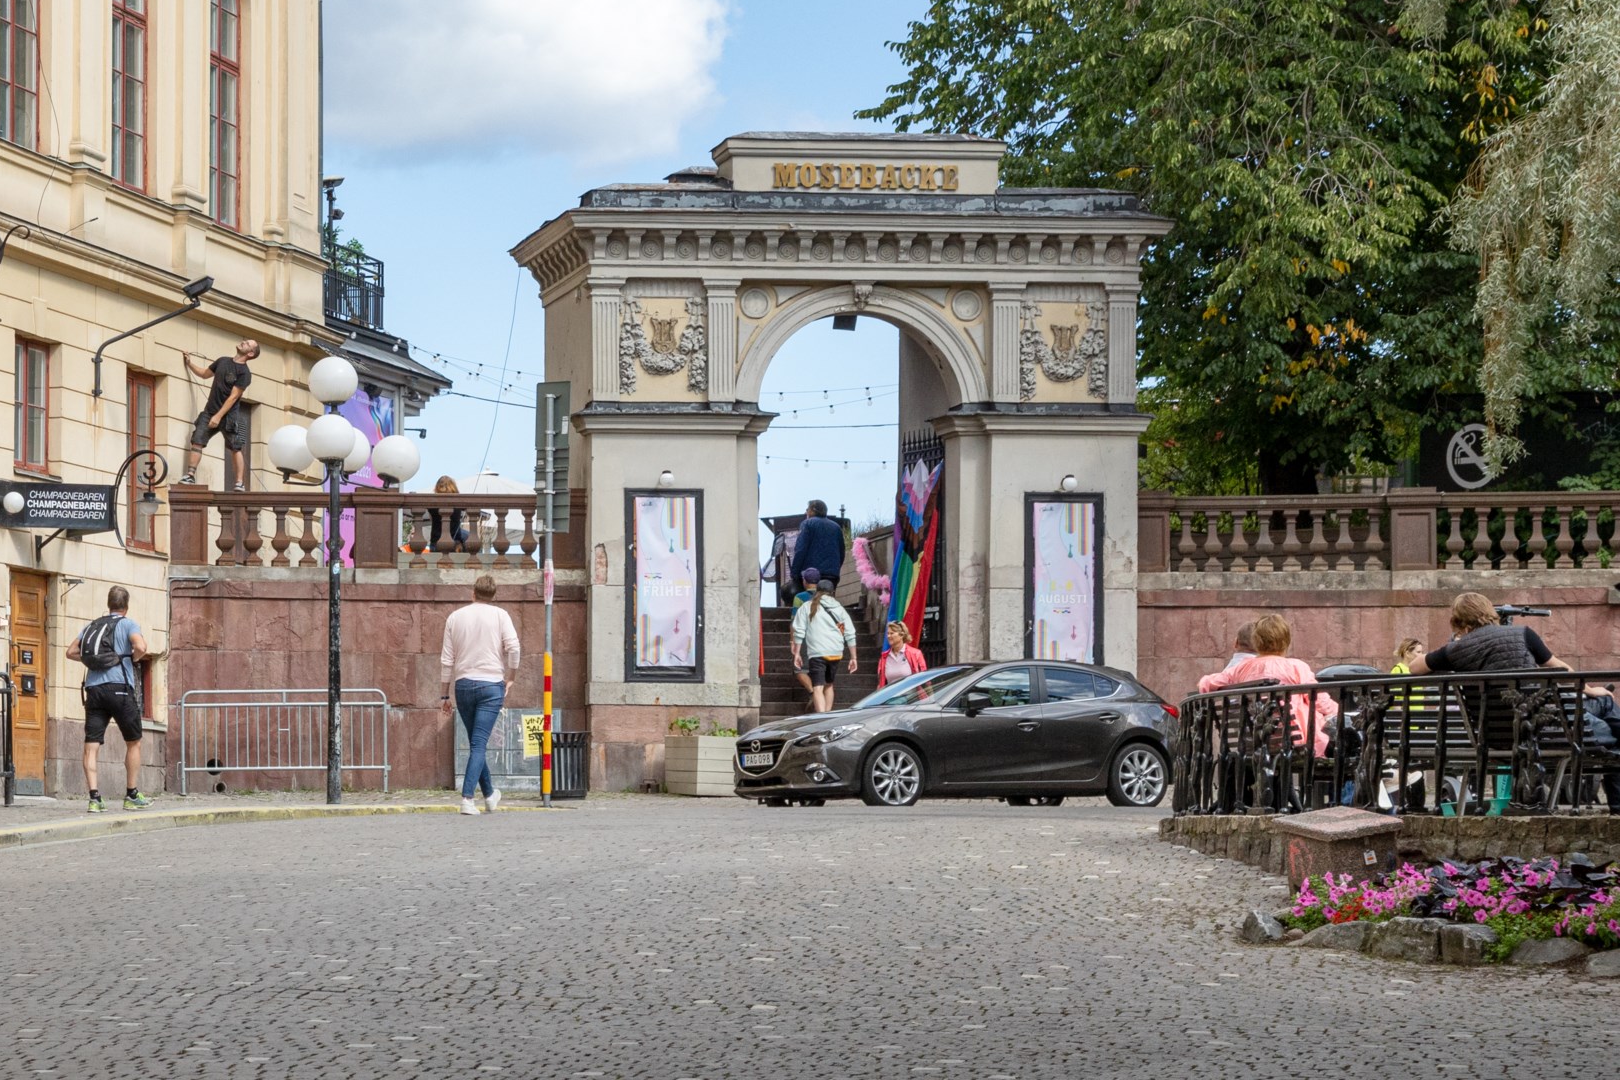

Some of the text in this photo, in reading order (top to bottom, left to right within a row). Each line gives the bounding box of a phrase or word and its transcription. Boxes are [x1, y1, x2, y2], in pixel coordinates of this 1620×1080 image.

[772, 162, 960, 191] MOSEBACKE
[142, 461, 157, 479] 3
[29, 490, 105, 501] CHAMPAGNEBAREN
[27, 499, 107, 510] CHAMPAGNEBAREN
[29, 509, 105, 519] CHAMPAGNEBAREN
[643, 585, 692, 597] FRIHET
[1039, 594, 1087, 604] AUGUSTI
[746, 754, 771, 765] PAG 098
